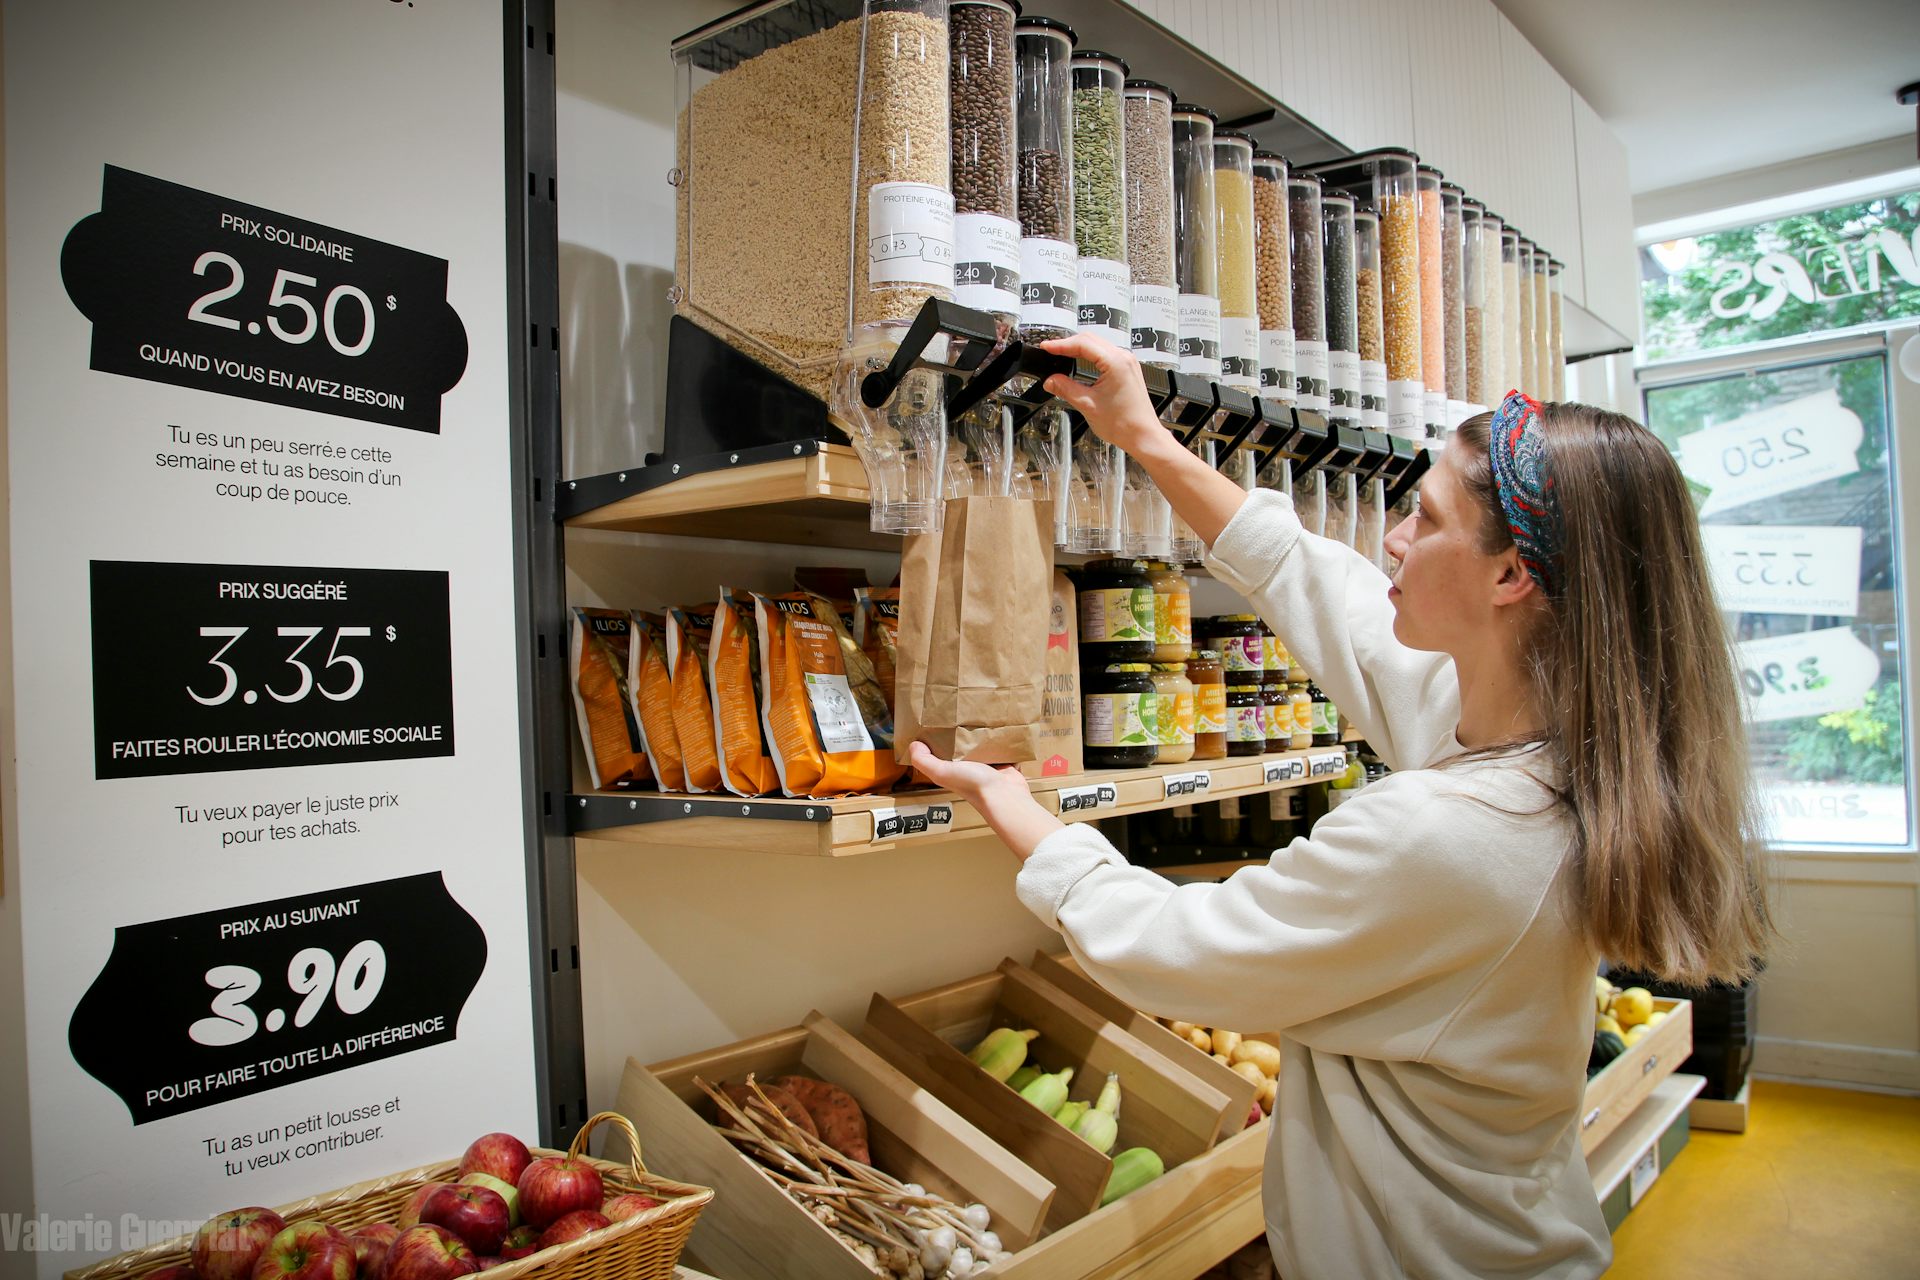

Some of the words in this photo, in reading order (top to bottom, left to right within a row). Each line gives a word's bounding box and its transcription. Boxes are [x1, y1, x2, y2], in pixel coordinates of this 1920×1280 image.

[222, 213, 261, 238] PRIX
[264, 226, 353, 262] SOLIDAIRE
[188, 252, 376, 357] 2.50
[140, 345, 210, 371] QUAND
[214, 359, 265, 382] VOUS
[269, 370, 293, 388] EN
[296, 376, 340, 398] AVEZ
[344, 385, 404, 410] BESOIN
[167, 425, 190, 443] Tu
[196, 433, 218, 446] es
[224, 435, 245, 449] un
[251, 438, 283, 453] peu
[289, 441, 346, 458] serré.e
[351, 447, 391, 463] cette
[156, 454, 235, 472] semaine
[241, 459, 257, 474] et
[262, 460, 278, 476] tu
[284, 465, 303, 478] as
[309, 463, 363, 483] besoin
[369, 469, 401, 486] d'un
[216, 484, 262, 501] coup
[267, 484, 289, 500] de
[295, 490, 351, 505] pouce.
[220, 582, 260, 598] PRIX
[263, 580, 347, 600] SUGGÉRÉ
[779, 602, 809, 615] ILIOS
[595, 620, 626, 631] ILIOS
[187, 627, 371, 705] 3.35
[113, 739, 180, 758] FAITES
[185, 735, 260, 754] ROULER
[264, 729, 370, 750] L'ÉCONOMIE
[373, 726, 442, 743] SOCIALE
[175, 806, 198, 823] Tu
[203, 806, 247, 821] veux
[253, 802, 302, 821] payer
[307, 797, 321, 813] le
[325, 795, 364, 815] juste
[369, 792, 399, 812] prix
[885, 820, 897, 831] 1.90
[223, 829, 264, 848] pour
[269, 825, 296, 840] tes
[301, 819, 360, 837] achats.
[221, 918, 260, 939] PRIX
[264, 913, 287, 931] AU
[291, 899, 360, 925] SUIVANT
[189, 940, 387, 1047] 3.90
[147, 1079, 201, 1106] POUR
[205, 1064, 256, 1091] FAIRE
[259, 1048, 319, 1075] TOUTE
[322, 1043, 343, 1060] LA
[346, 1016, 444, 1053] DIFFÉRENCE
[202, 1138, 225, 1156] Tu
[231, 1135, 252, 1150] as
[258, 1128, 279, 1144] un
[285, 1115, 322, 1142] petit
[327, 1105, 381, 1127] lousse
[385, 1097, 400, 1113] et
[225, 1161, 242, 1176] tu
[247, 1149, 290, 1170] veux
[295, 1125, 384, 1159] contribuer.
